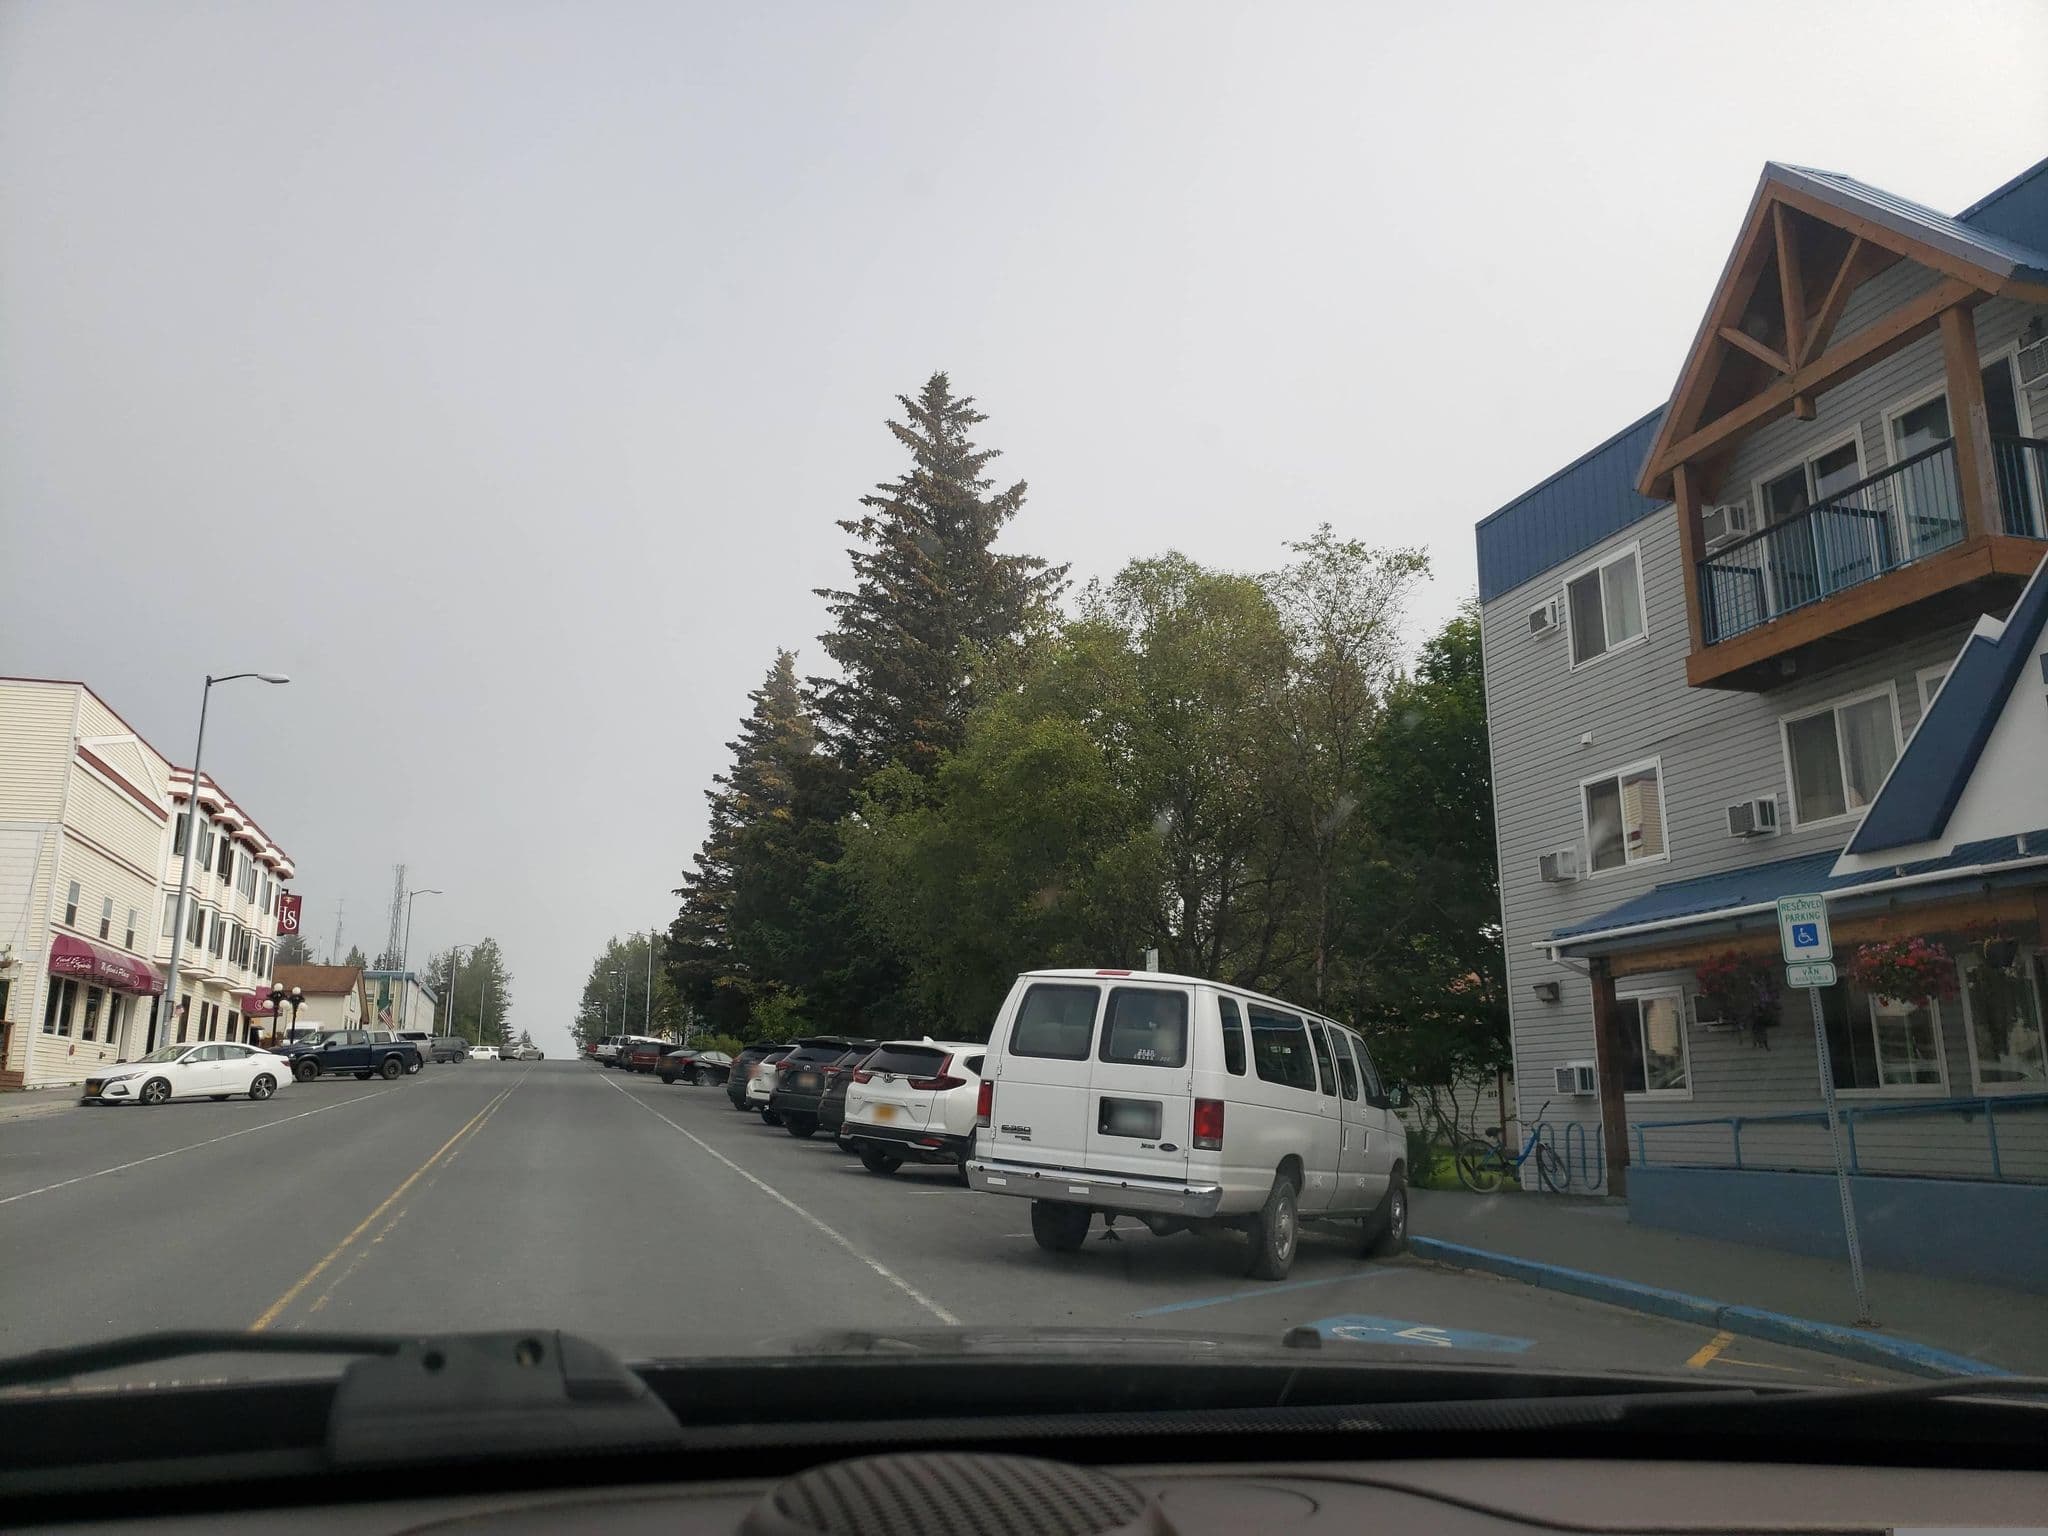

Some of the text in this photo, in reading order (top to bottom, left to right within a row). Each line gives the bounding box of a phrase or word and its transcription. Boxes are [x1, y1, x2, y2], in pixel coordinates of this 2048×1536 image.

[1781, 901, 1822, 912] RESERVED
[1785, 912, 1820, 922] PARKING
[1802, 967, 1819, 976] VAN
